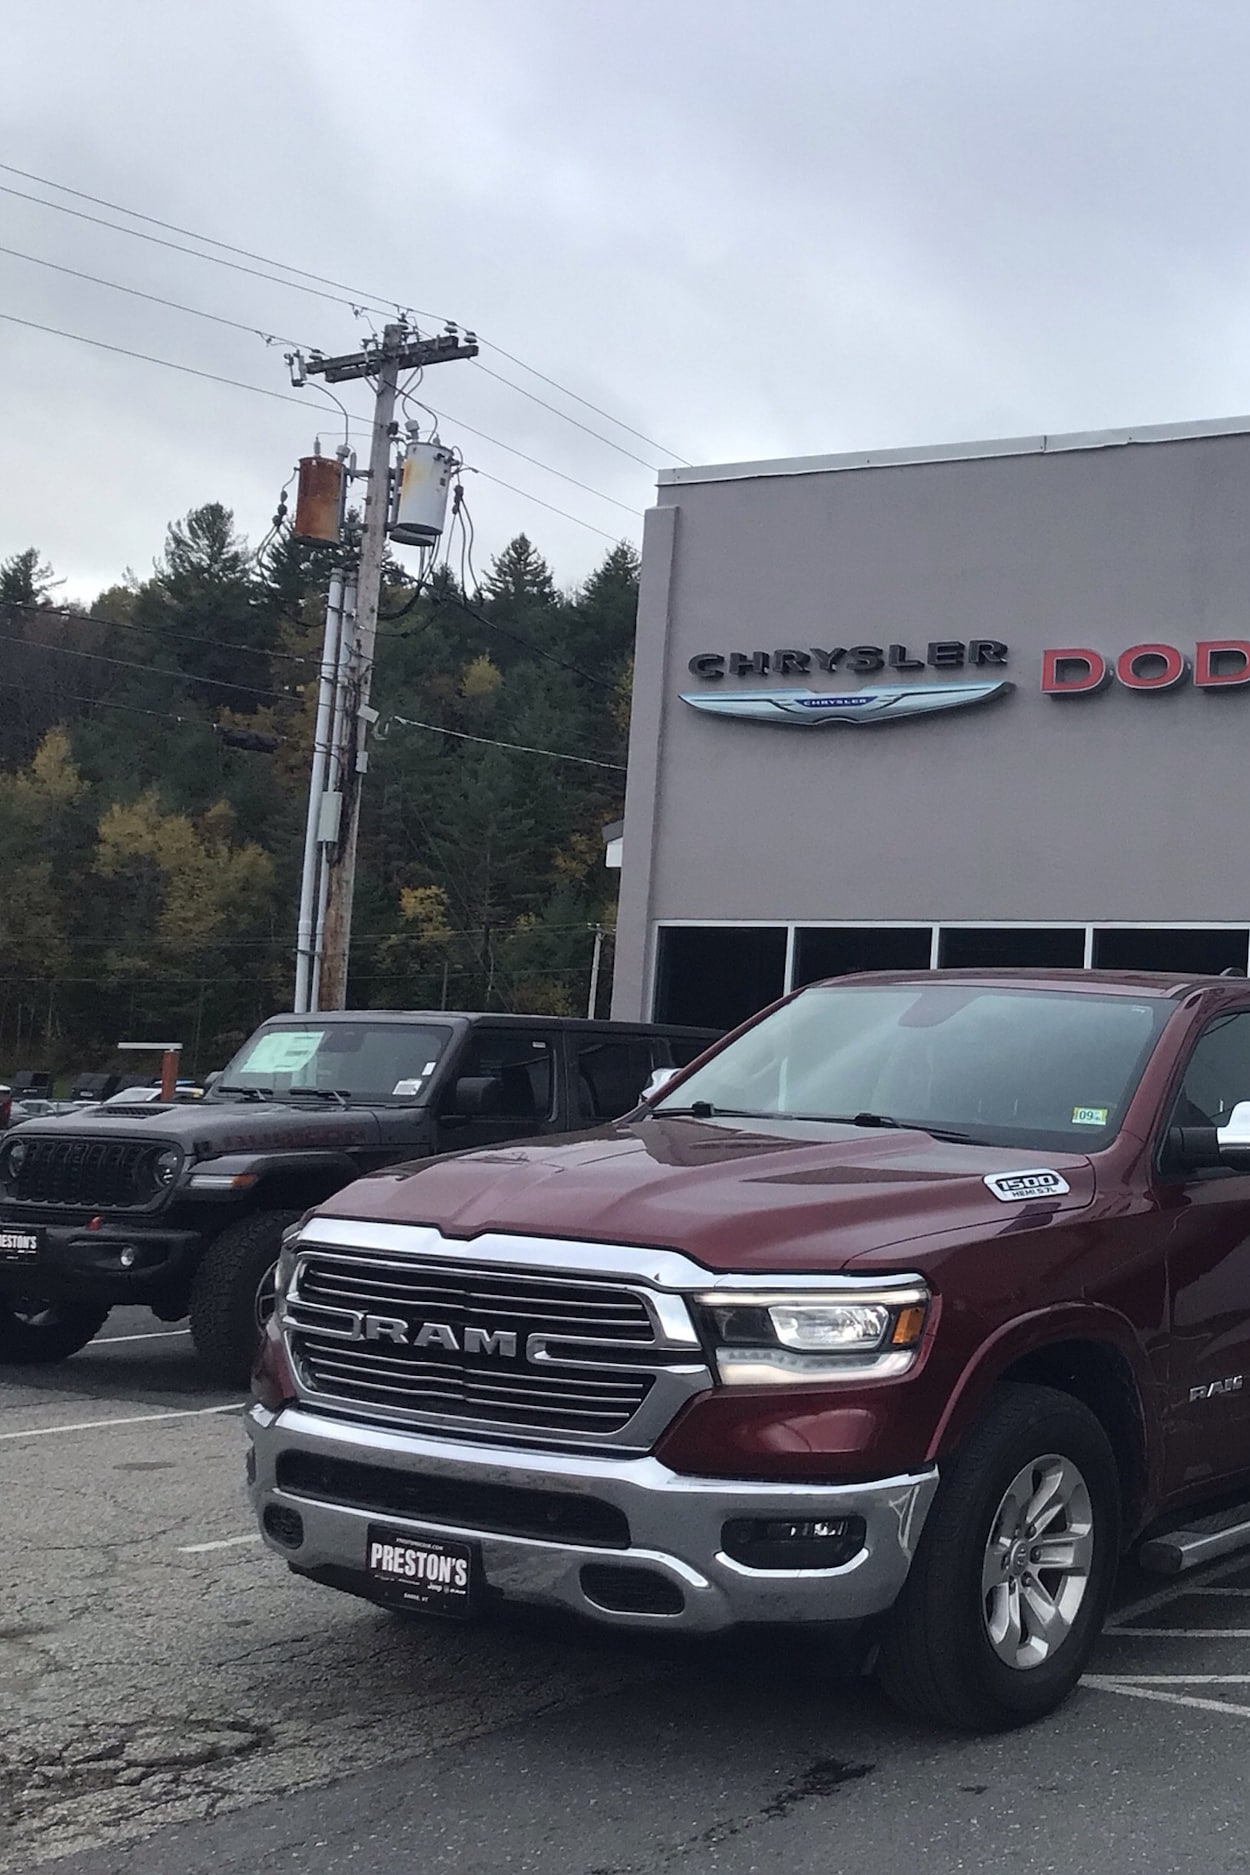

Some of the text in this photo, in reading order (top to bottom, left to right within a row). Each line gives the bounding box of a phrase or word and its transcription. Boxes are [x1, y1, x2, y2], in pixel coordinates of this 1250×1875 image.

[688, 640, 1008, 679] CHRYSLER
[803, 698, 867, 706] CHRYSLER
[998, 1175, 1054, 1191] 1500
[1012, 1188, 1034, 1197] HEMI
[0, 1234, 37, 1249] ESTON'S
[366, 1314, 517, 1358] RAM
[1189, 1375, 1243, 1402] RAM
[371, 1542, 468, 1587] PRESTON'S
